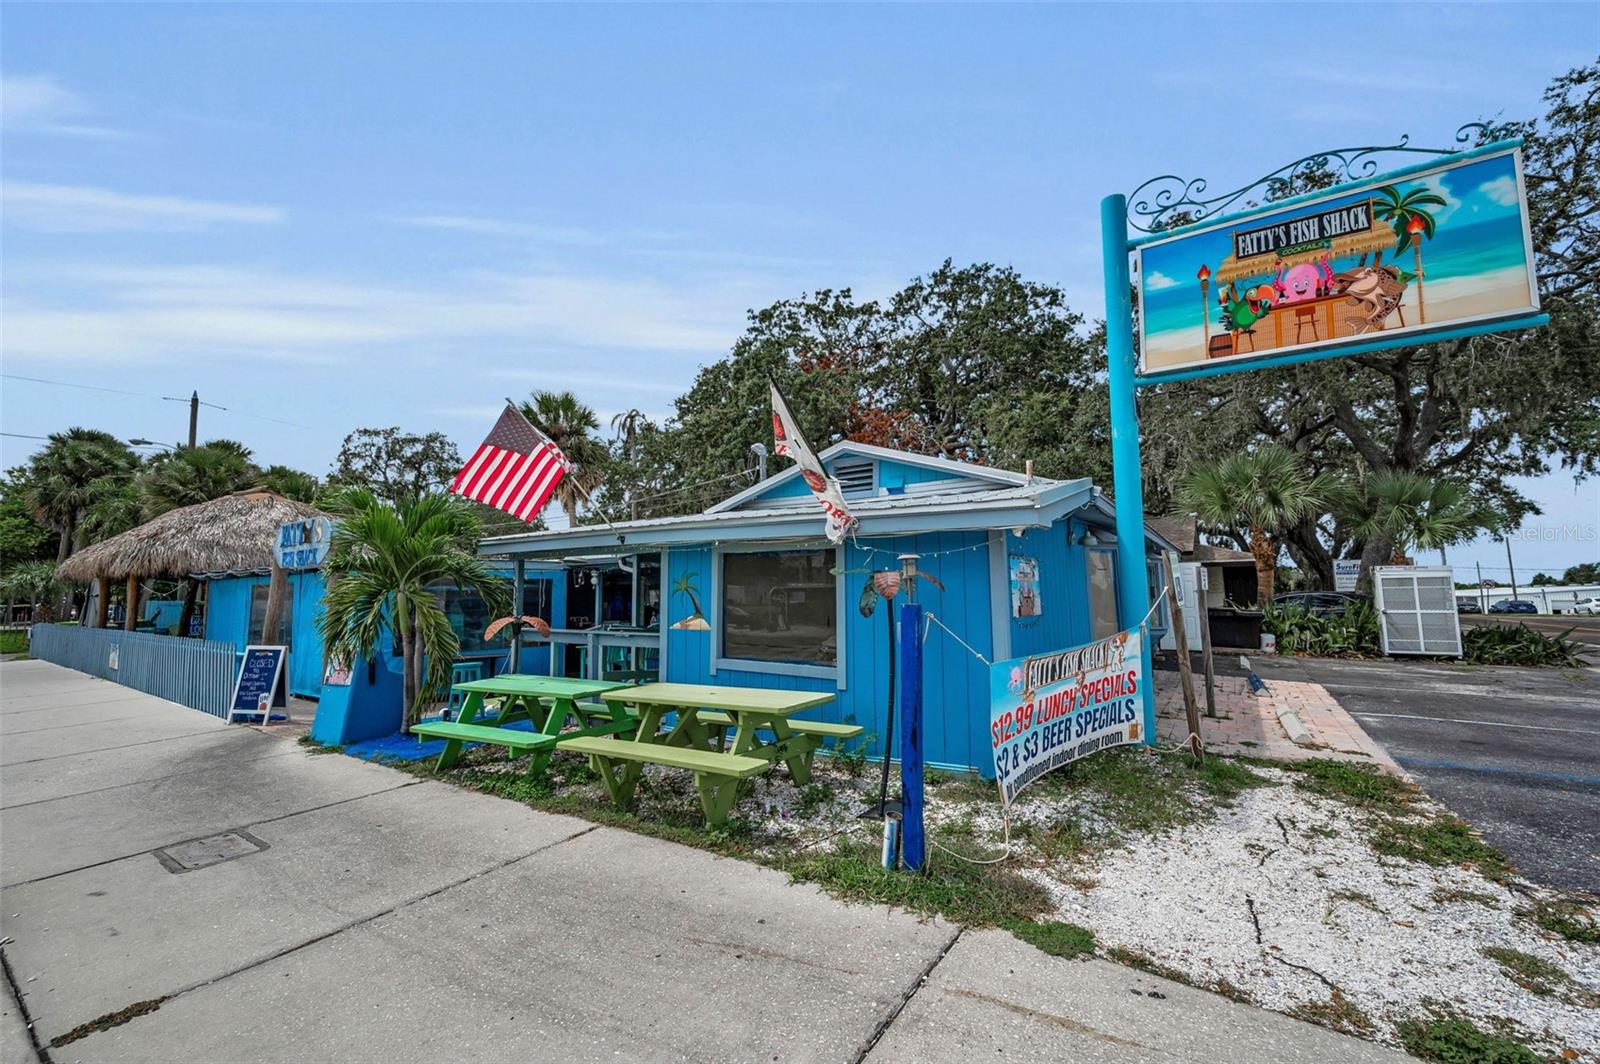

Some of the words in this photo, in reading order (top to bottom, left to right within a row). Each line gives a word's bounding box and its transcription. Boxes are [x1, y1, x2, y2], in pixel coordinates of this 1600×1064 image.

[1238, 226, 1287, 257] FATTY'S
[1290, 217, 1319, 244] FISH
[1323, 206, 1369, 236] SHACK
[1281, 241, 1324, 256] COCKTAILS
[249, 658, 274, 668] CLOSED
[992, 703, 1034, 748] $12.99
[1036, 689, 1077, 725] LUNCH
[1079, 670, 1137, 708] SPECIALS
[996, 747, 1010, 781] $2
[1012, 743, 1019, 769] &
[1023, 730, 1039, 763] $3
[1042, 717, 1072, 753] BEER
[1075, 698, 1135, 739] SPECIALS
[1014, 756, 1051, 793] conditioned
[1052, 747, 1077, 766] indoor
[1078, 738, 1100, 756] dining
[1101, 731, 1123, 748] room
